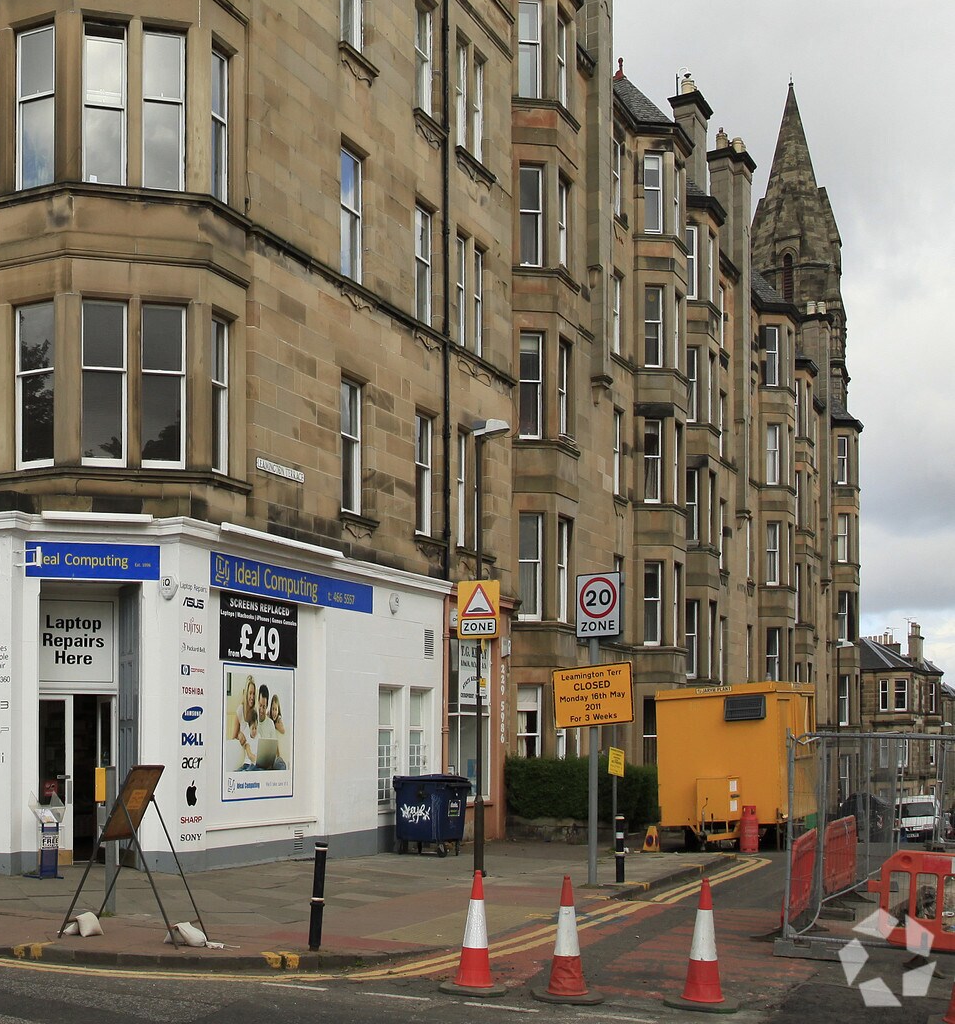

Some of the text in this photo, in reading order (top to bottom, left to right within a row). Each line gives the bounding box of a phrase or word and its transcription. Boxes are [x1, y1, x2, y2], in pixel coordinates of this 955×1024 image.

[32, 552, 60, 565] Ieal
[64, 553, 129, 570] Computing
[162, 578, 171, 587] iQ
[234, 561, 260, 587] Ideal
[263, 568, 318, 603] Computing
[333, 593, 343, 604] 466
[343, 594, 355, 605] 5557
[182, 597, 204, 609] ASUS
[585, 589, 612, 607] 20
[229, 598, 290, 616] SCREENS REPLACED
[46, 615, 102, 633] Laptop
[184, 619, 203, 635] FUJITSU
[463, 621, 493, 632] ZONE
[581, 620, 615, 632] ZONE
[42, 633, 105, 650] Repairs
[228, 623, 281, 662] from £49
[54, 651, 93, 665] Here
[561, 671, 604, 682] Leamington
[182, 686, 204, 696] TOSHIBA
[573, 681, 611, 691] CLOSED
[559, 691, 626, 703] Monday 16th May
[570, 712, 618, 723] For 3 Weeks
[181, 732, 204, 746] DELL
[181, 757, 203, 770] acer
[180, 816, 203, 824] SHARP
[180, 833, 202, 842] SONY
